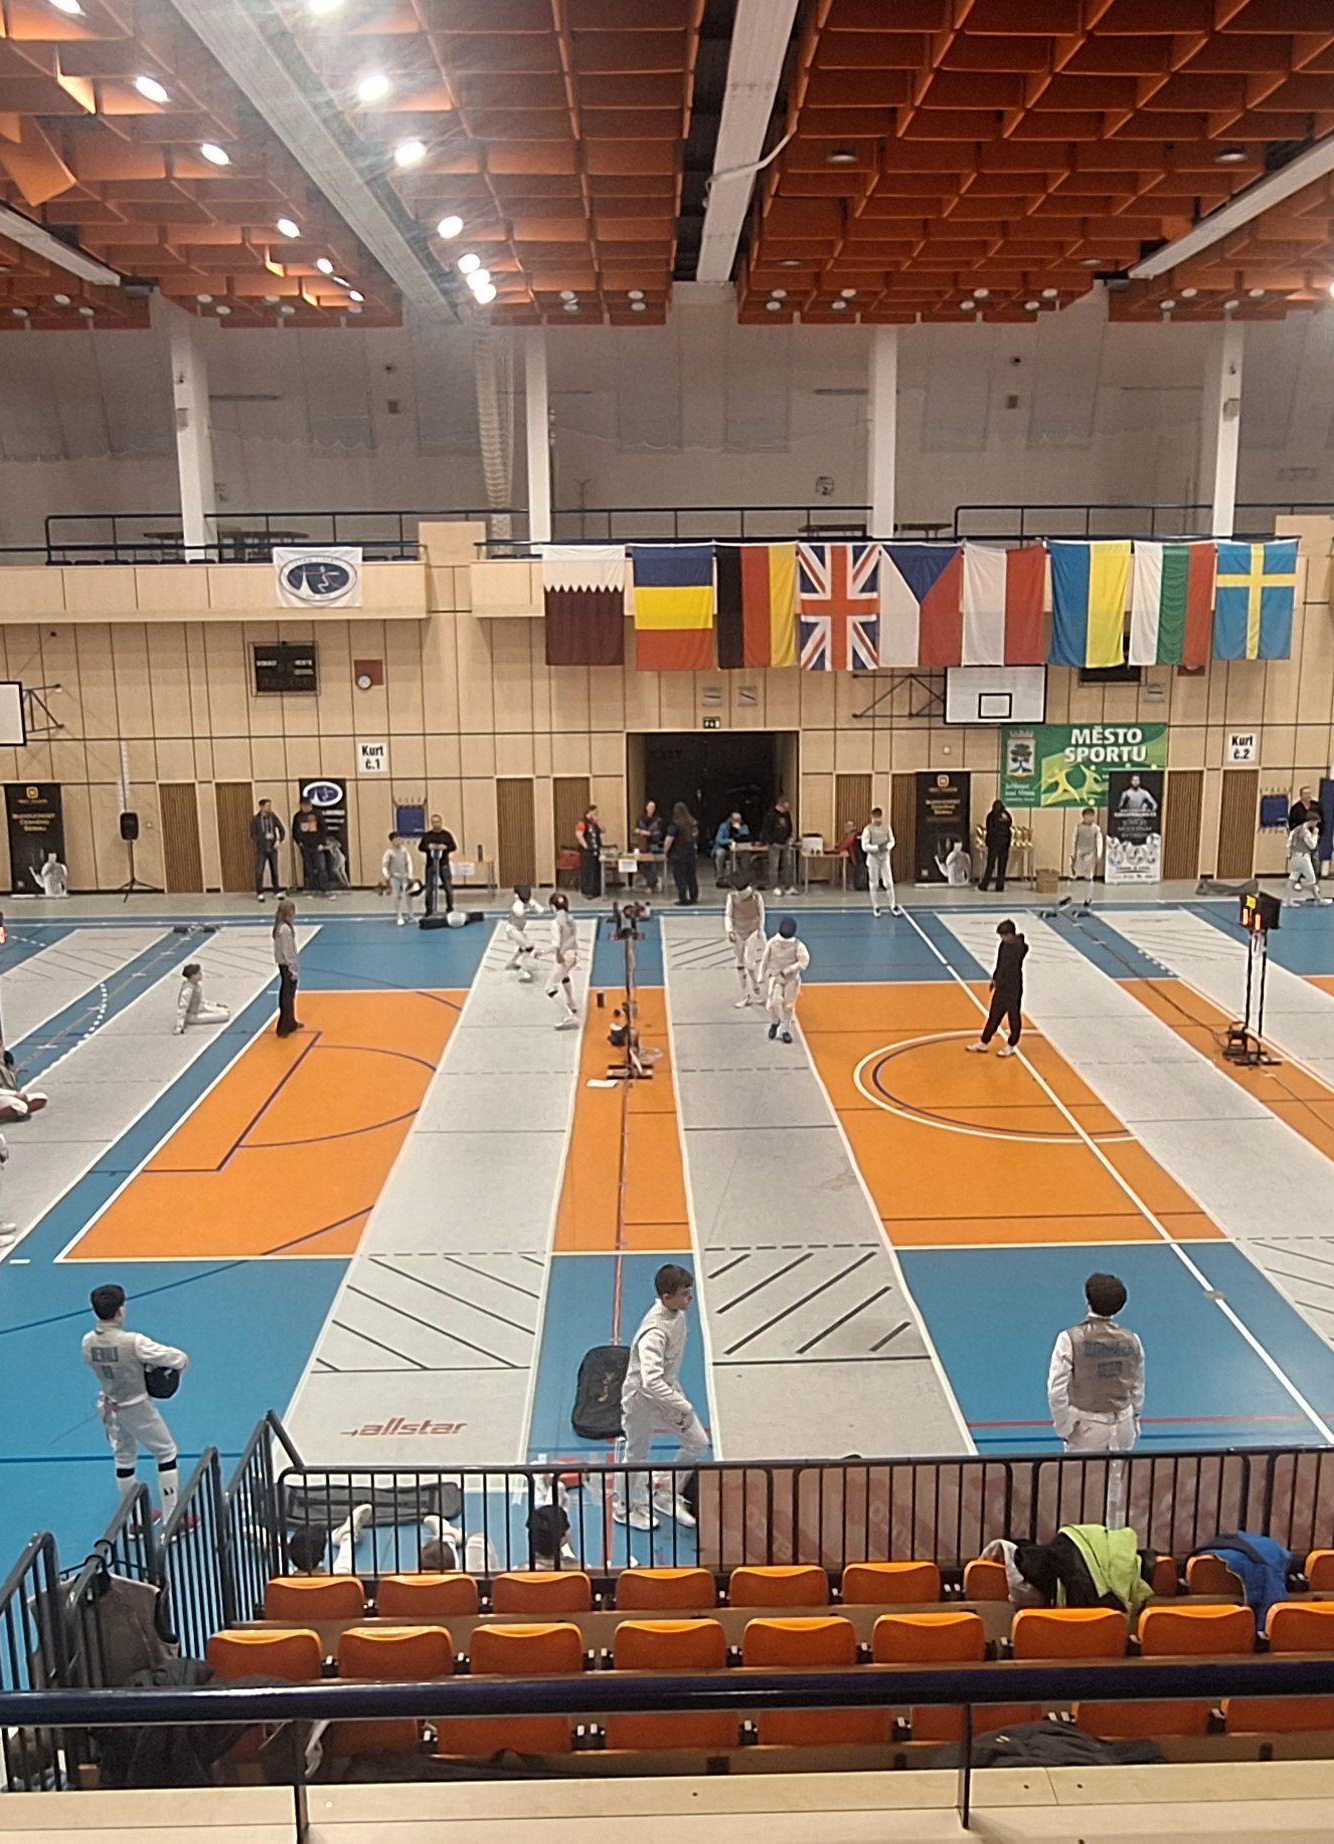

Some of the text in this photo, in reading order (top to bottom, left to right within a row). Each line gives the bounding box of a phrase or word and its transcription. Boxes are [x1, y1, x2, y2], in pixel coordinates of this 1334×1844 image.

[1071, 725, 1143, 745] MĚSTO
[1232, 735, 1253, 746] Kurt
[362, 745, 384, 757] Kurt
[1064, 746, 1147, 763] SPORTU
[1234, 748, 1250, 760] č.2
[365, 758, 381, 770] č.1
[359, 1417, 468, 1437] allstar
